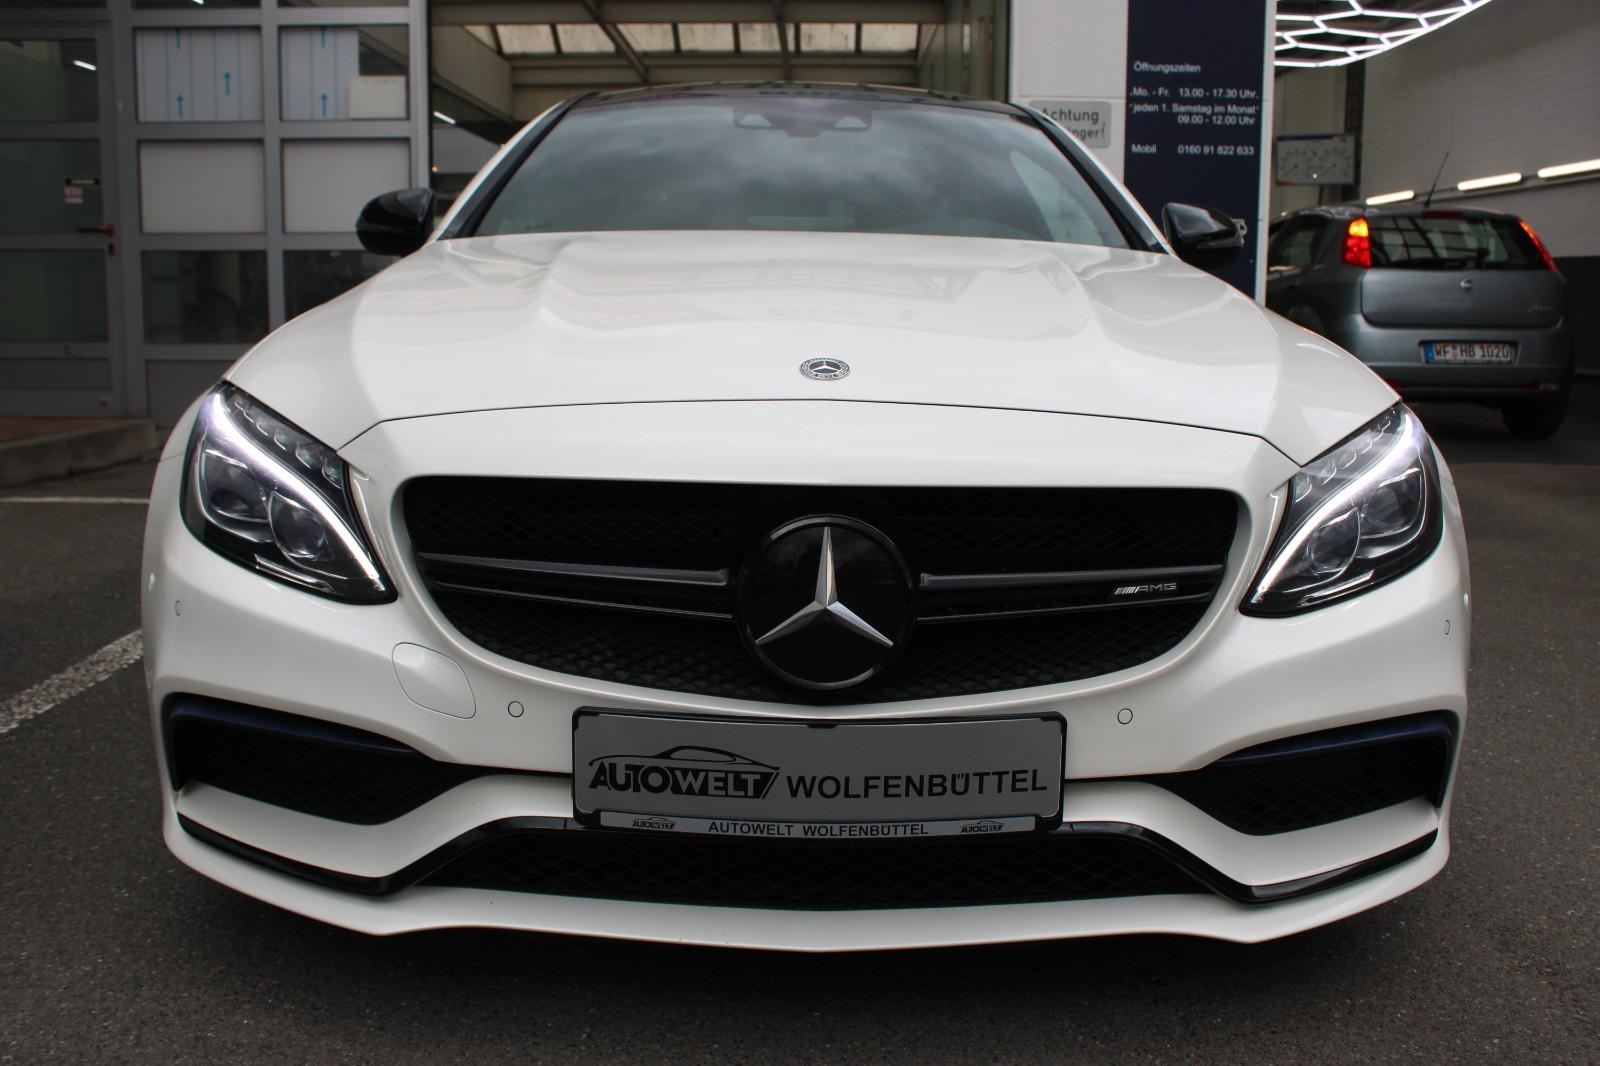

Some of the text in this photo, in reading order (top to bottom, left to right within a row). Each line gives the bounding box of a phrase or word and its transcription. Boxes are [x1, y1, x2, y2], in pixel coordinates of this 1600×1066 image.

[1133, 60, 1201, 74] Öffnungszeiten
[1179, 87, 1204, 98] 13.00
[1212, 88, 1238, 98] 17.30
[1132, 102, 1256, 115] jeden 1. Samstag im Monat
[1177, 114, 1204, 125] 09.00
[1211, 115, 1237, 125] 12.00
[1238, 115, 1255, 125] Uhr
[1131, 143, 1157, 154] Mobil
[1460, 344, 1476, 358] HB
[1137, 582, 1177, 593] AMG
[588, 760, 1048, 799] AUTOWELT WOLFENBÜTTEL
[708, 821, 794, 837] AUTOWELT
[802, 823, 929, 837] WOLFENBÜTTEL
